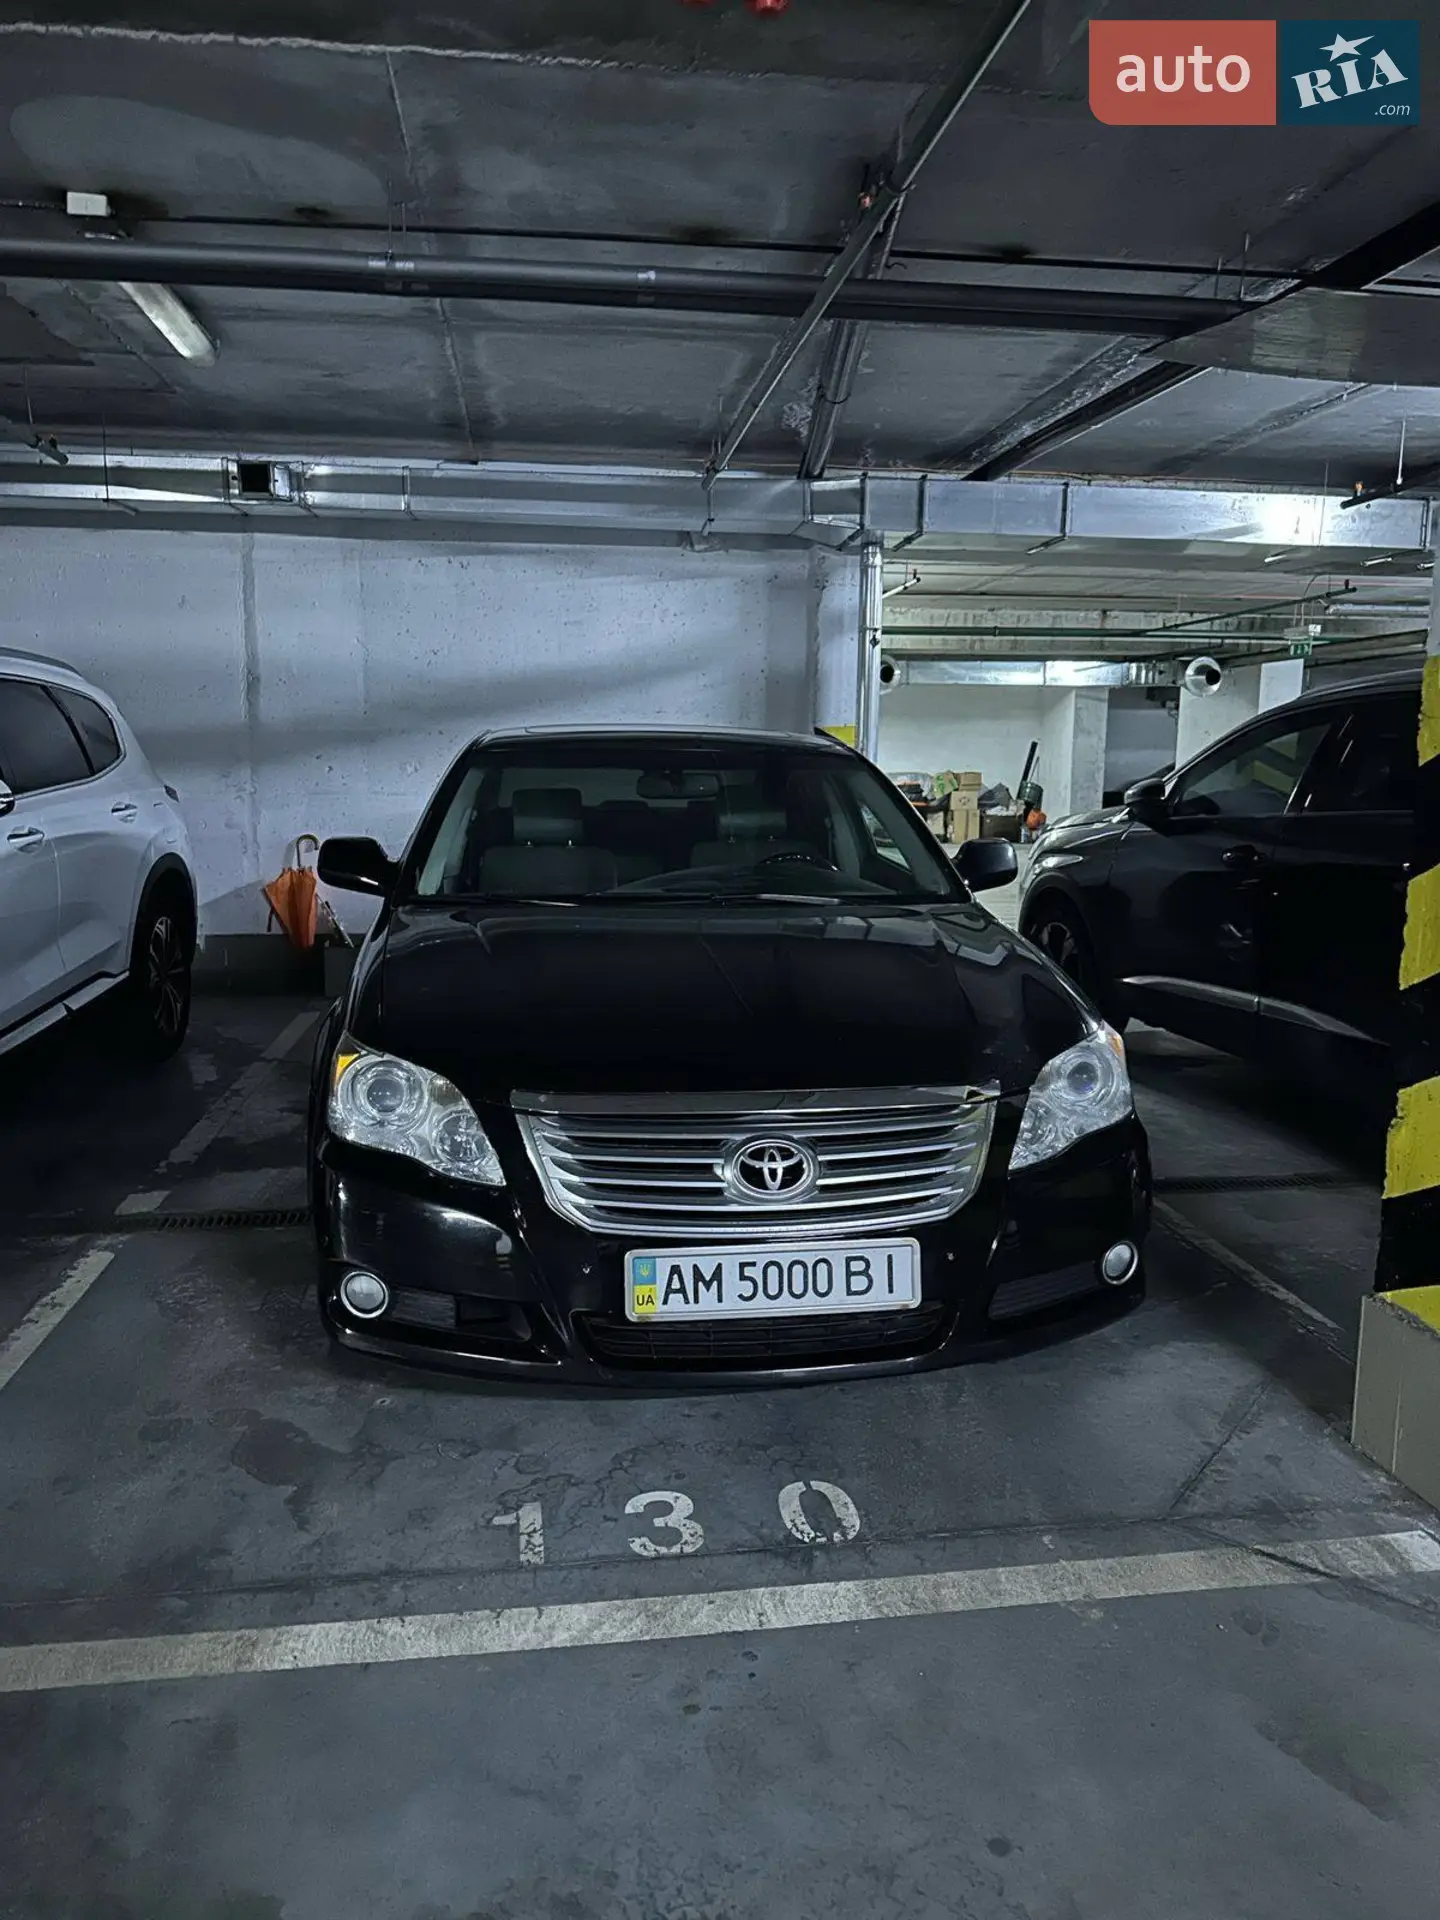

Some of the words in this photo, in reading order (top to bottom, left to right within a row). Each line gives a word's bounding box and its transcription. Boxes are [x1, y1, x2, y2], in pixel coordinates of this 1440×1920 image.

[661, 1262, 724, 1306] AM
[737, 1257, 834, 1302] 5000
[844, 1253, 895, 1297] BI
[636, 1294, 655, 1307] UA
